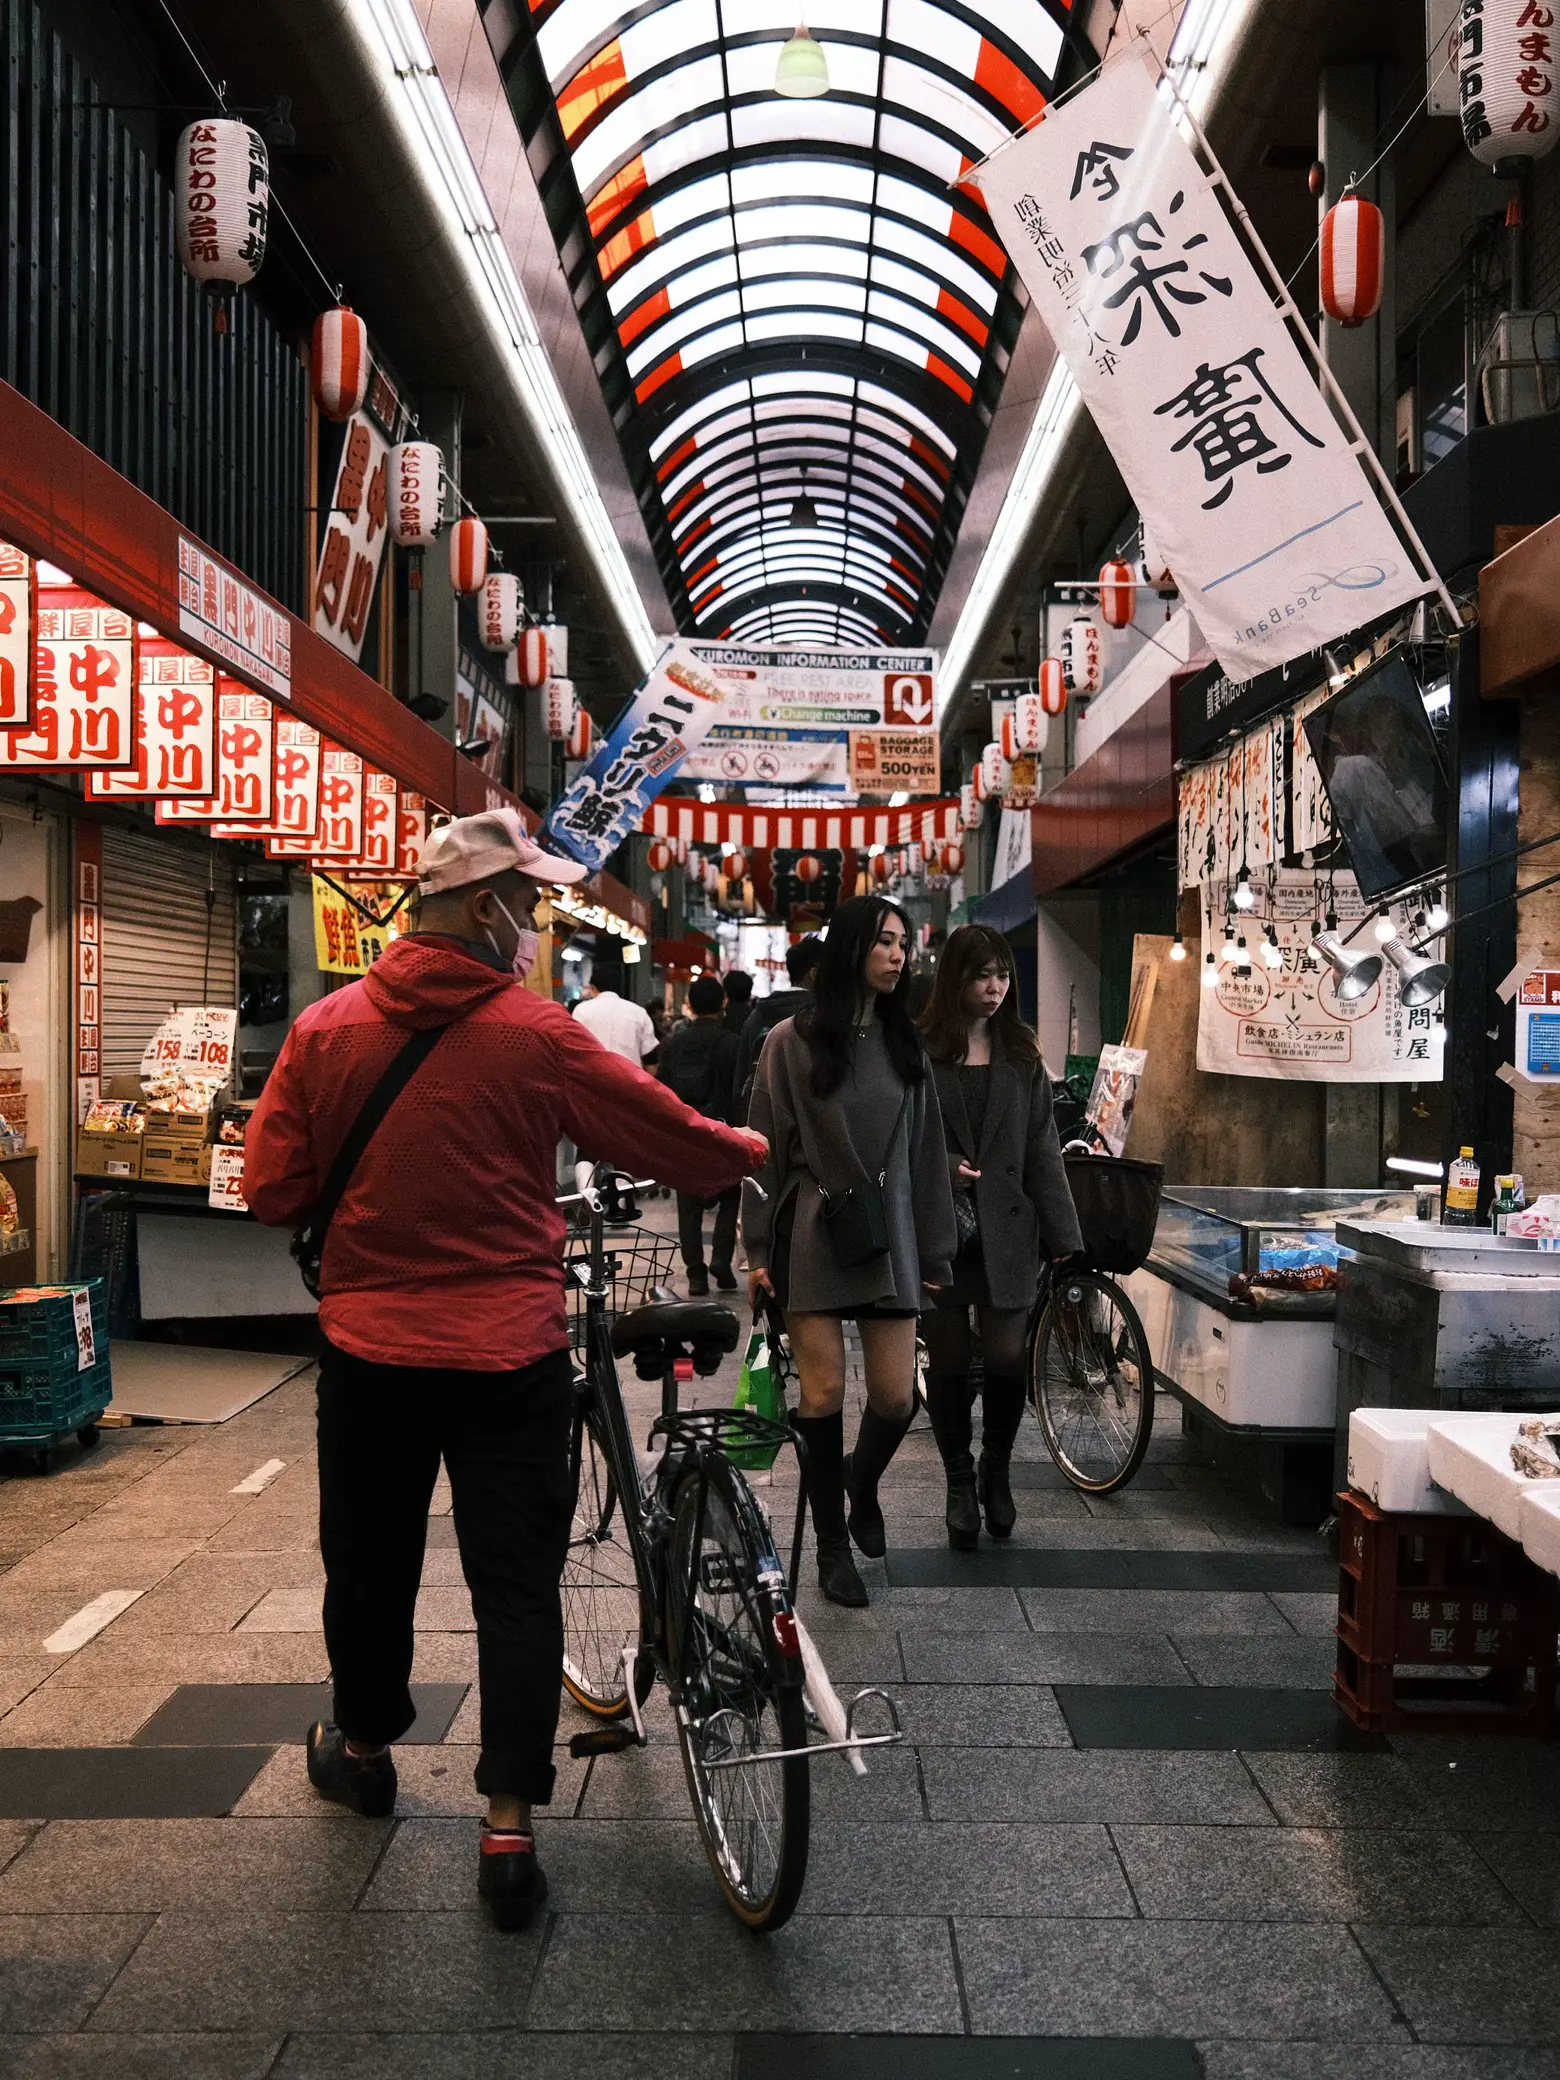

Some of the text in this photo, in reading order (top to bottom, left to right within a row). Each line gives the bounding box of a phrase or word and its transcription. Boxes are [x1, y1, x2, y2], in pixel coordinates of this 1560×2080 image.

[188, 125, 220, 262] なにわの台所
[400, 446, 421, 536] なにわの台所
[204, 629, 275, 686] KUROMON NAKAGAWA
[699, 650, 925, 671] KUROMON INFORMATION CENTER
[1084, 627, 1099, 691] ほんまもん
[801, 674, 832, 688] REST
[842, 676, 875, 689] AREA
[68, 644, 121, 760] 中川
[767, 686, 872, 701] There is eating space
[780, 708, 871, 721] Change machine
[158, 688, 203, 790] 中川
[880, 736, 934, 745] BAGGAGE
[880, 745, 934, 755] STORAGE
[221, 724, 263, 814] 中川
[277, 749, 310, 831] 中川
[320, 776, 354, 851] 中川
[83, 865, 95, 1021] 黒門中川
[1221, 981, 1265, 997] 中央市場
[1244, 997, 1263, 1005] Market
[1244, 1025, 1346, 1042] 飲食店・ミシュラン店
[1264, 1040, 1301, 1048] MICHELIN
[156, 1040, 182, 1060] 158
[200, 1041, 229, 1064] 108
